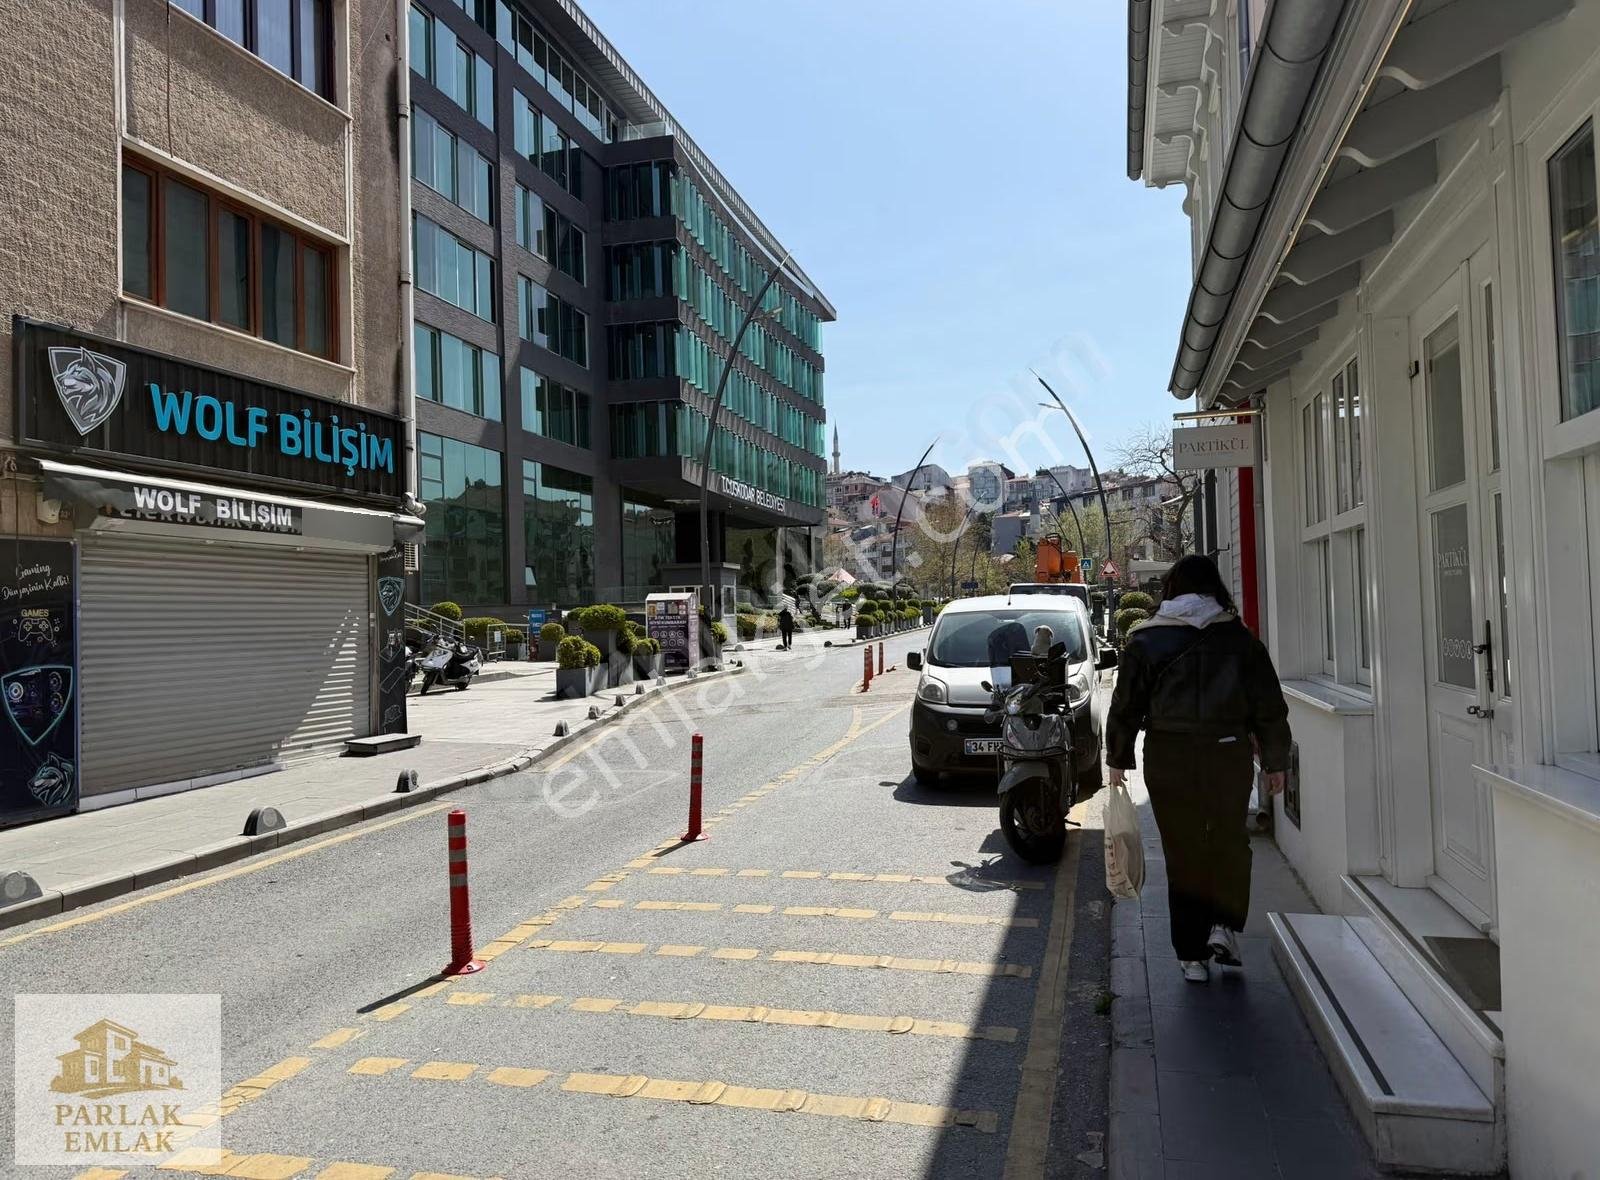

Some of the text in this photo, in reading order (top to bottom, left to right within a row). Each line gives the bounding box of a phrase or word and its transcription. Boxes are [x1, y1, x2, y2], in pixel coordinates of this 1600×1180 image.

[149, 383, 394, 477] WOLF BİLİŞİM
[1178, 437, 1249, 454] PARTİKÜL
[133, 486, 201, 514] WOLF
[216, 497, 292, 527] BİLİŞİM
[15, 563, 51, 580] Gaming
[21, 608, 49, 617] GAMES
[972, 742, 984, 752] 34
